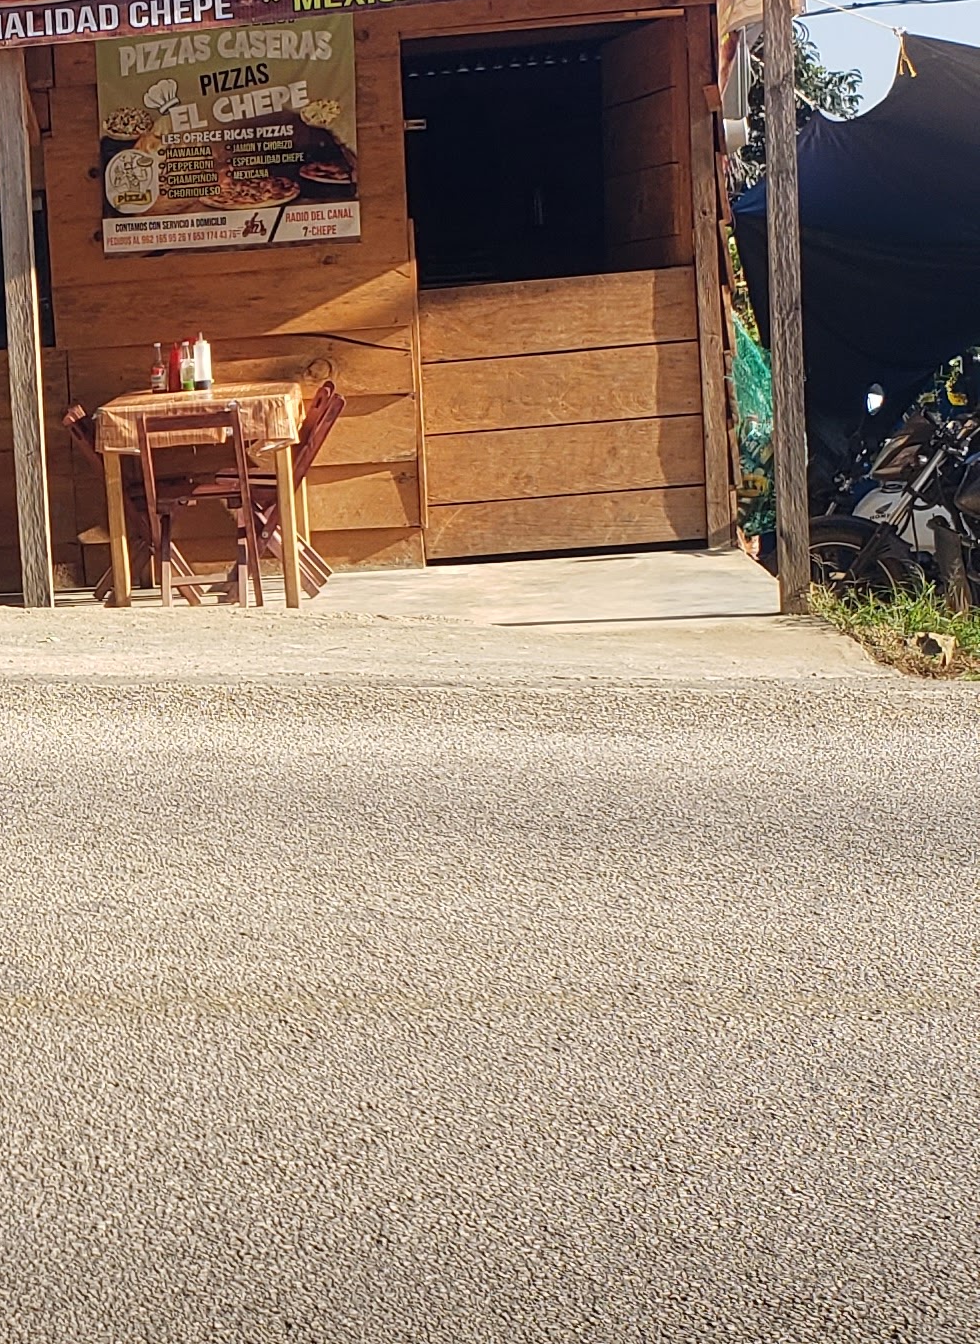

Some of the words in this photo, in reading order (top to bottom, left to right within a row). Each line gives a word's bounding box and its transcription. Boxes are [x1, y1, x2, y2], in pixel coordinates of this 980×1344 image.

[119, 34, 212, 77] PIZZAS
[216, 29, 332, 61] CASERAS
[199, 63, 270, 96] PIZZAS
[169, 103, 208, 133] EL
[212, 80, 310, 123] CHEPE
[161, 132, 181, 145] LES
[183, 129, 222, 144] OFRECE
[223, 127, 254, 142] RICAS
[256, 125, 294, 139] PIZZAS
[166, 147, 212, 158] HAWAIANA
[232, 155, 281, 167] ESPECIALIDAD
[281, 152, 305, 163] CHEPE
[167, 160, 214, 172] PEPPERONI
[168, 186, 221, 198] CHORIQUESO
[285, 211, 309, 223] RADIO
[311, 210, 326, 221] DEL
[328, 208, 354, 220] CANAL
